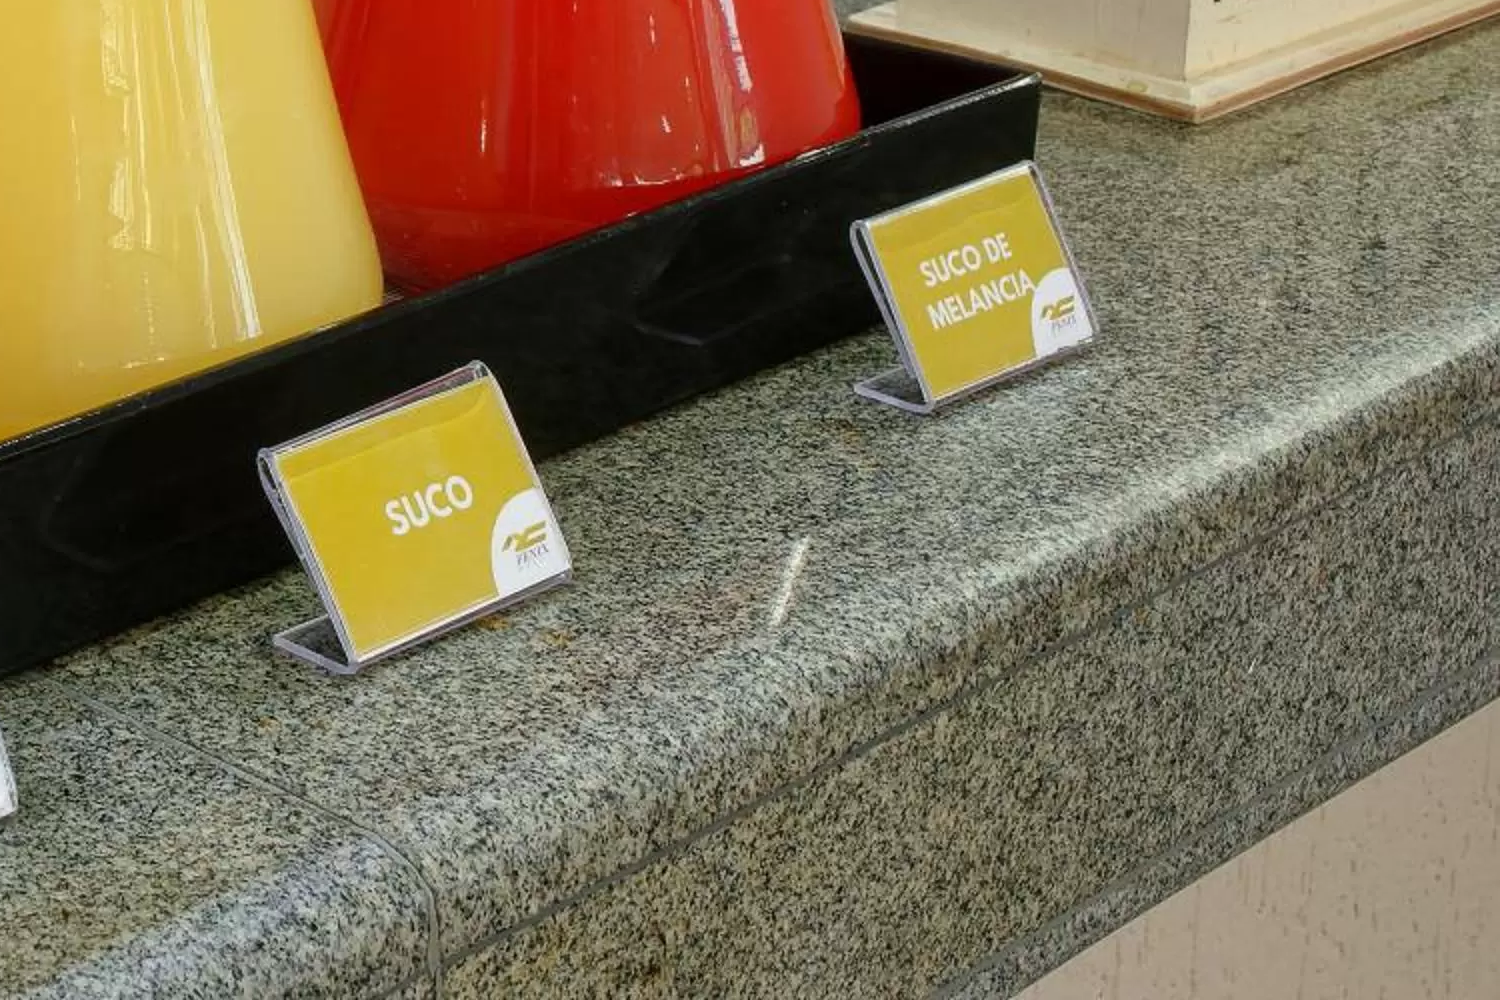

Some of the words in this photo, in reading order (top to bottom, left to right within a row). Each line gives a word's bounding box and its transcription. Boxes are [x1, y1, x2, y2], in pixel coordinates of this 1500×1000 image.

[919, 245, 981, 288] SUCO
[981, 233, 1013, 264] DE
[926, 268, 1036, 332] MELANCIA
[385, 475, 473, 536] SUCO
